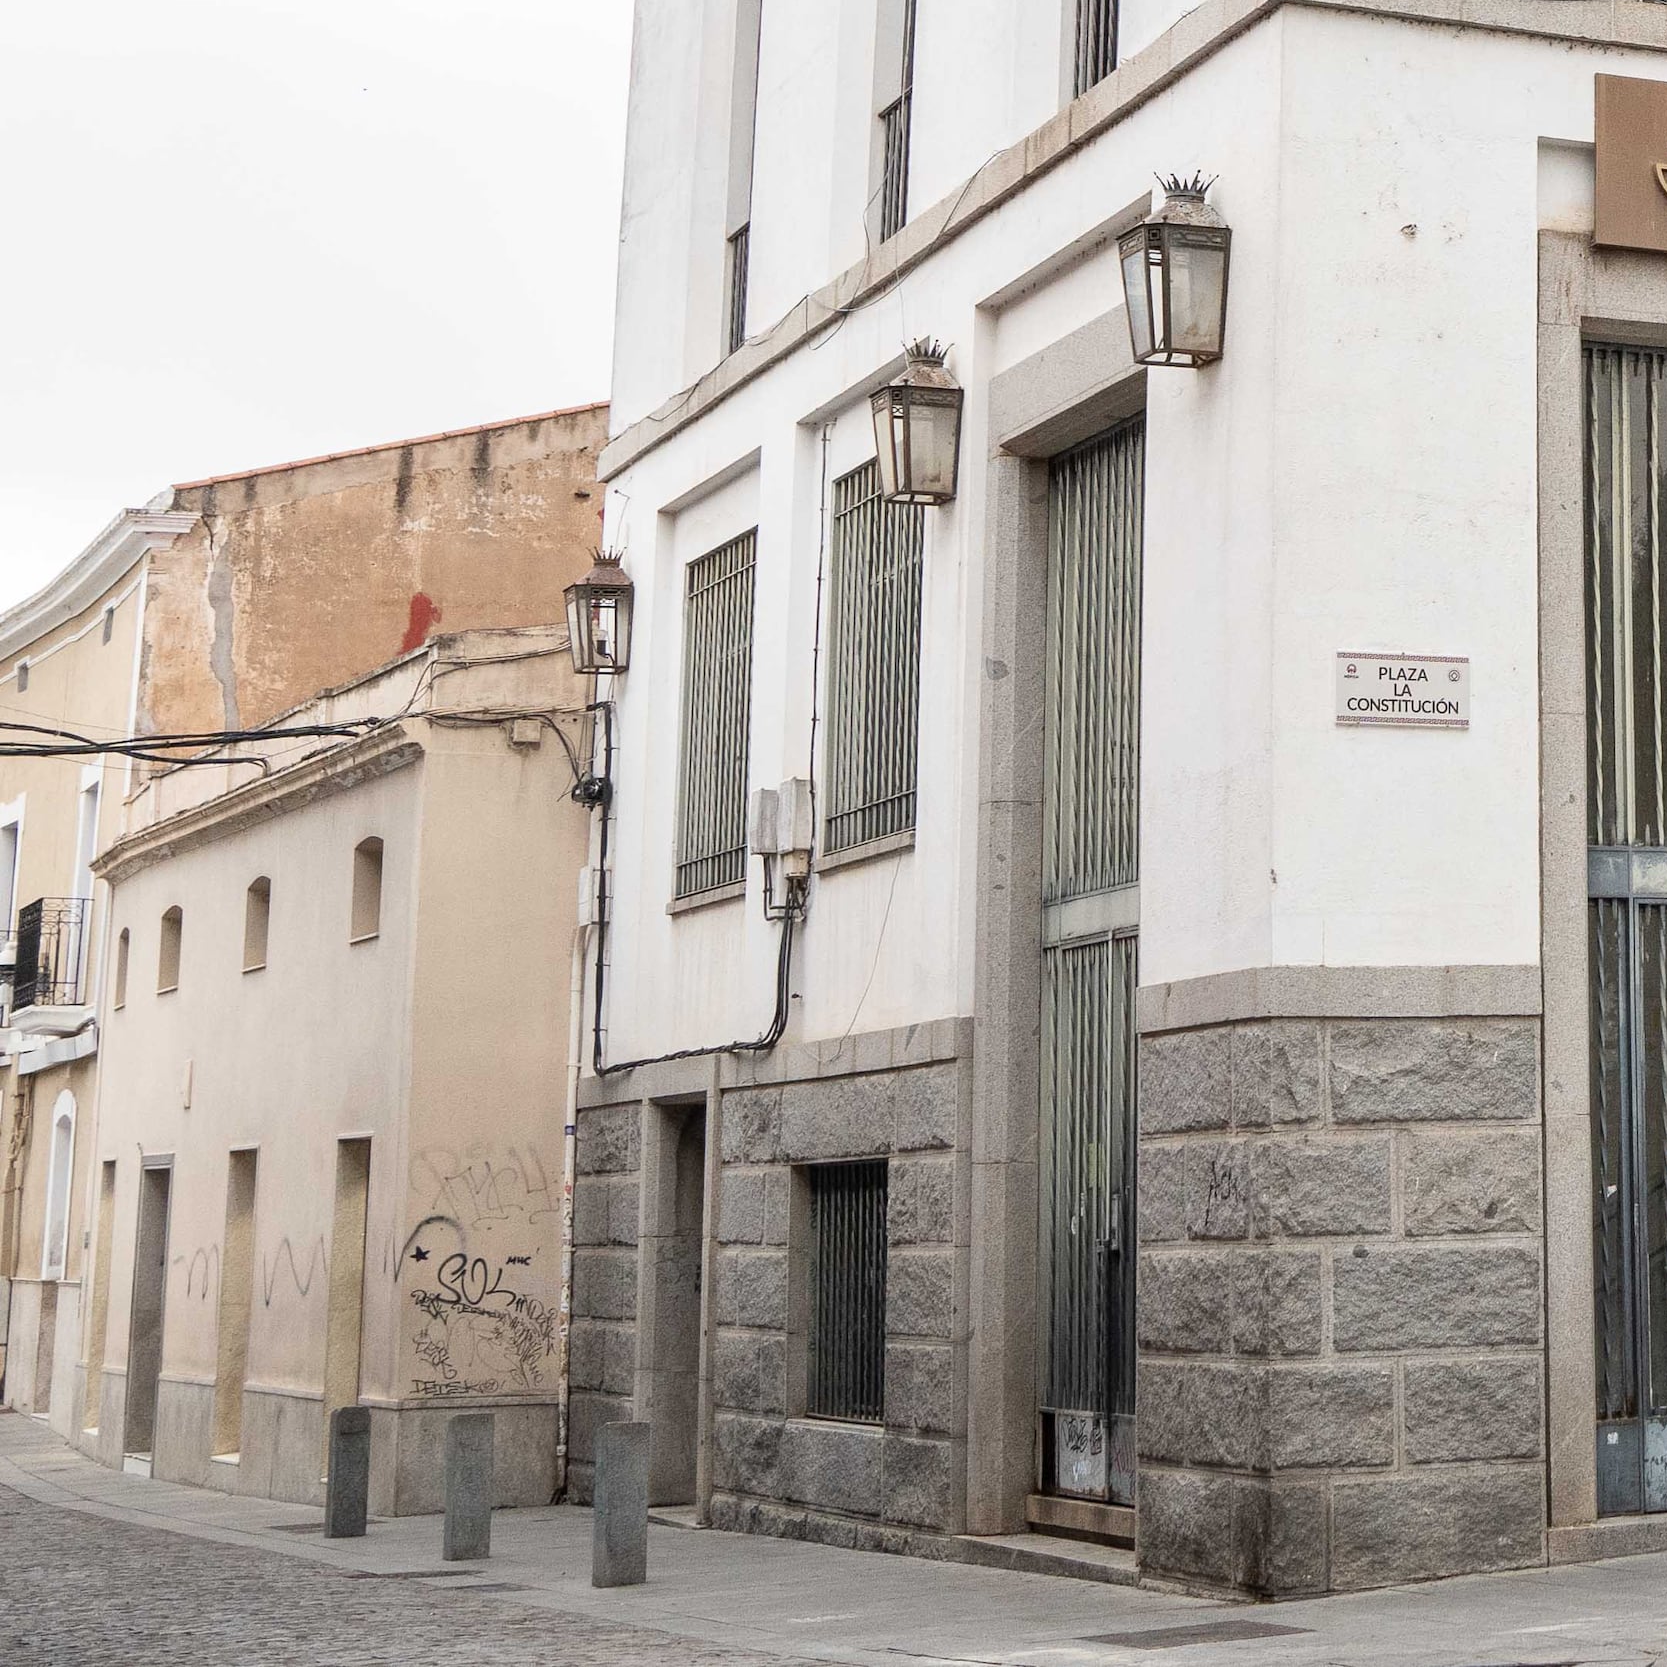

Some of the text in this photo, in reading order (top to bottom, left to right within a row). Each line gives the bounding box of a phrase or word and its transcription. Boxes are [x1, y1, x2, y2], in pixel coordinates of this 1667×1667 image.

[1378, 667, 1429, 682] PLAZA
[1394, 683, 1412, 697] LA
[1347, 697, 1459, 714] CONSTITUCIÓN
